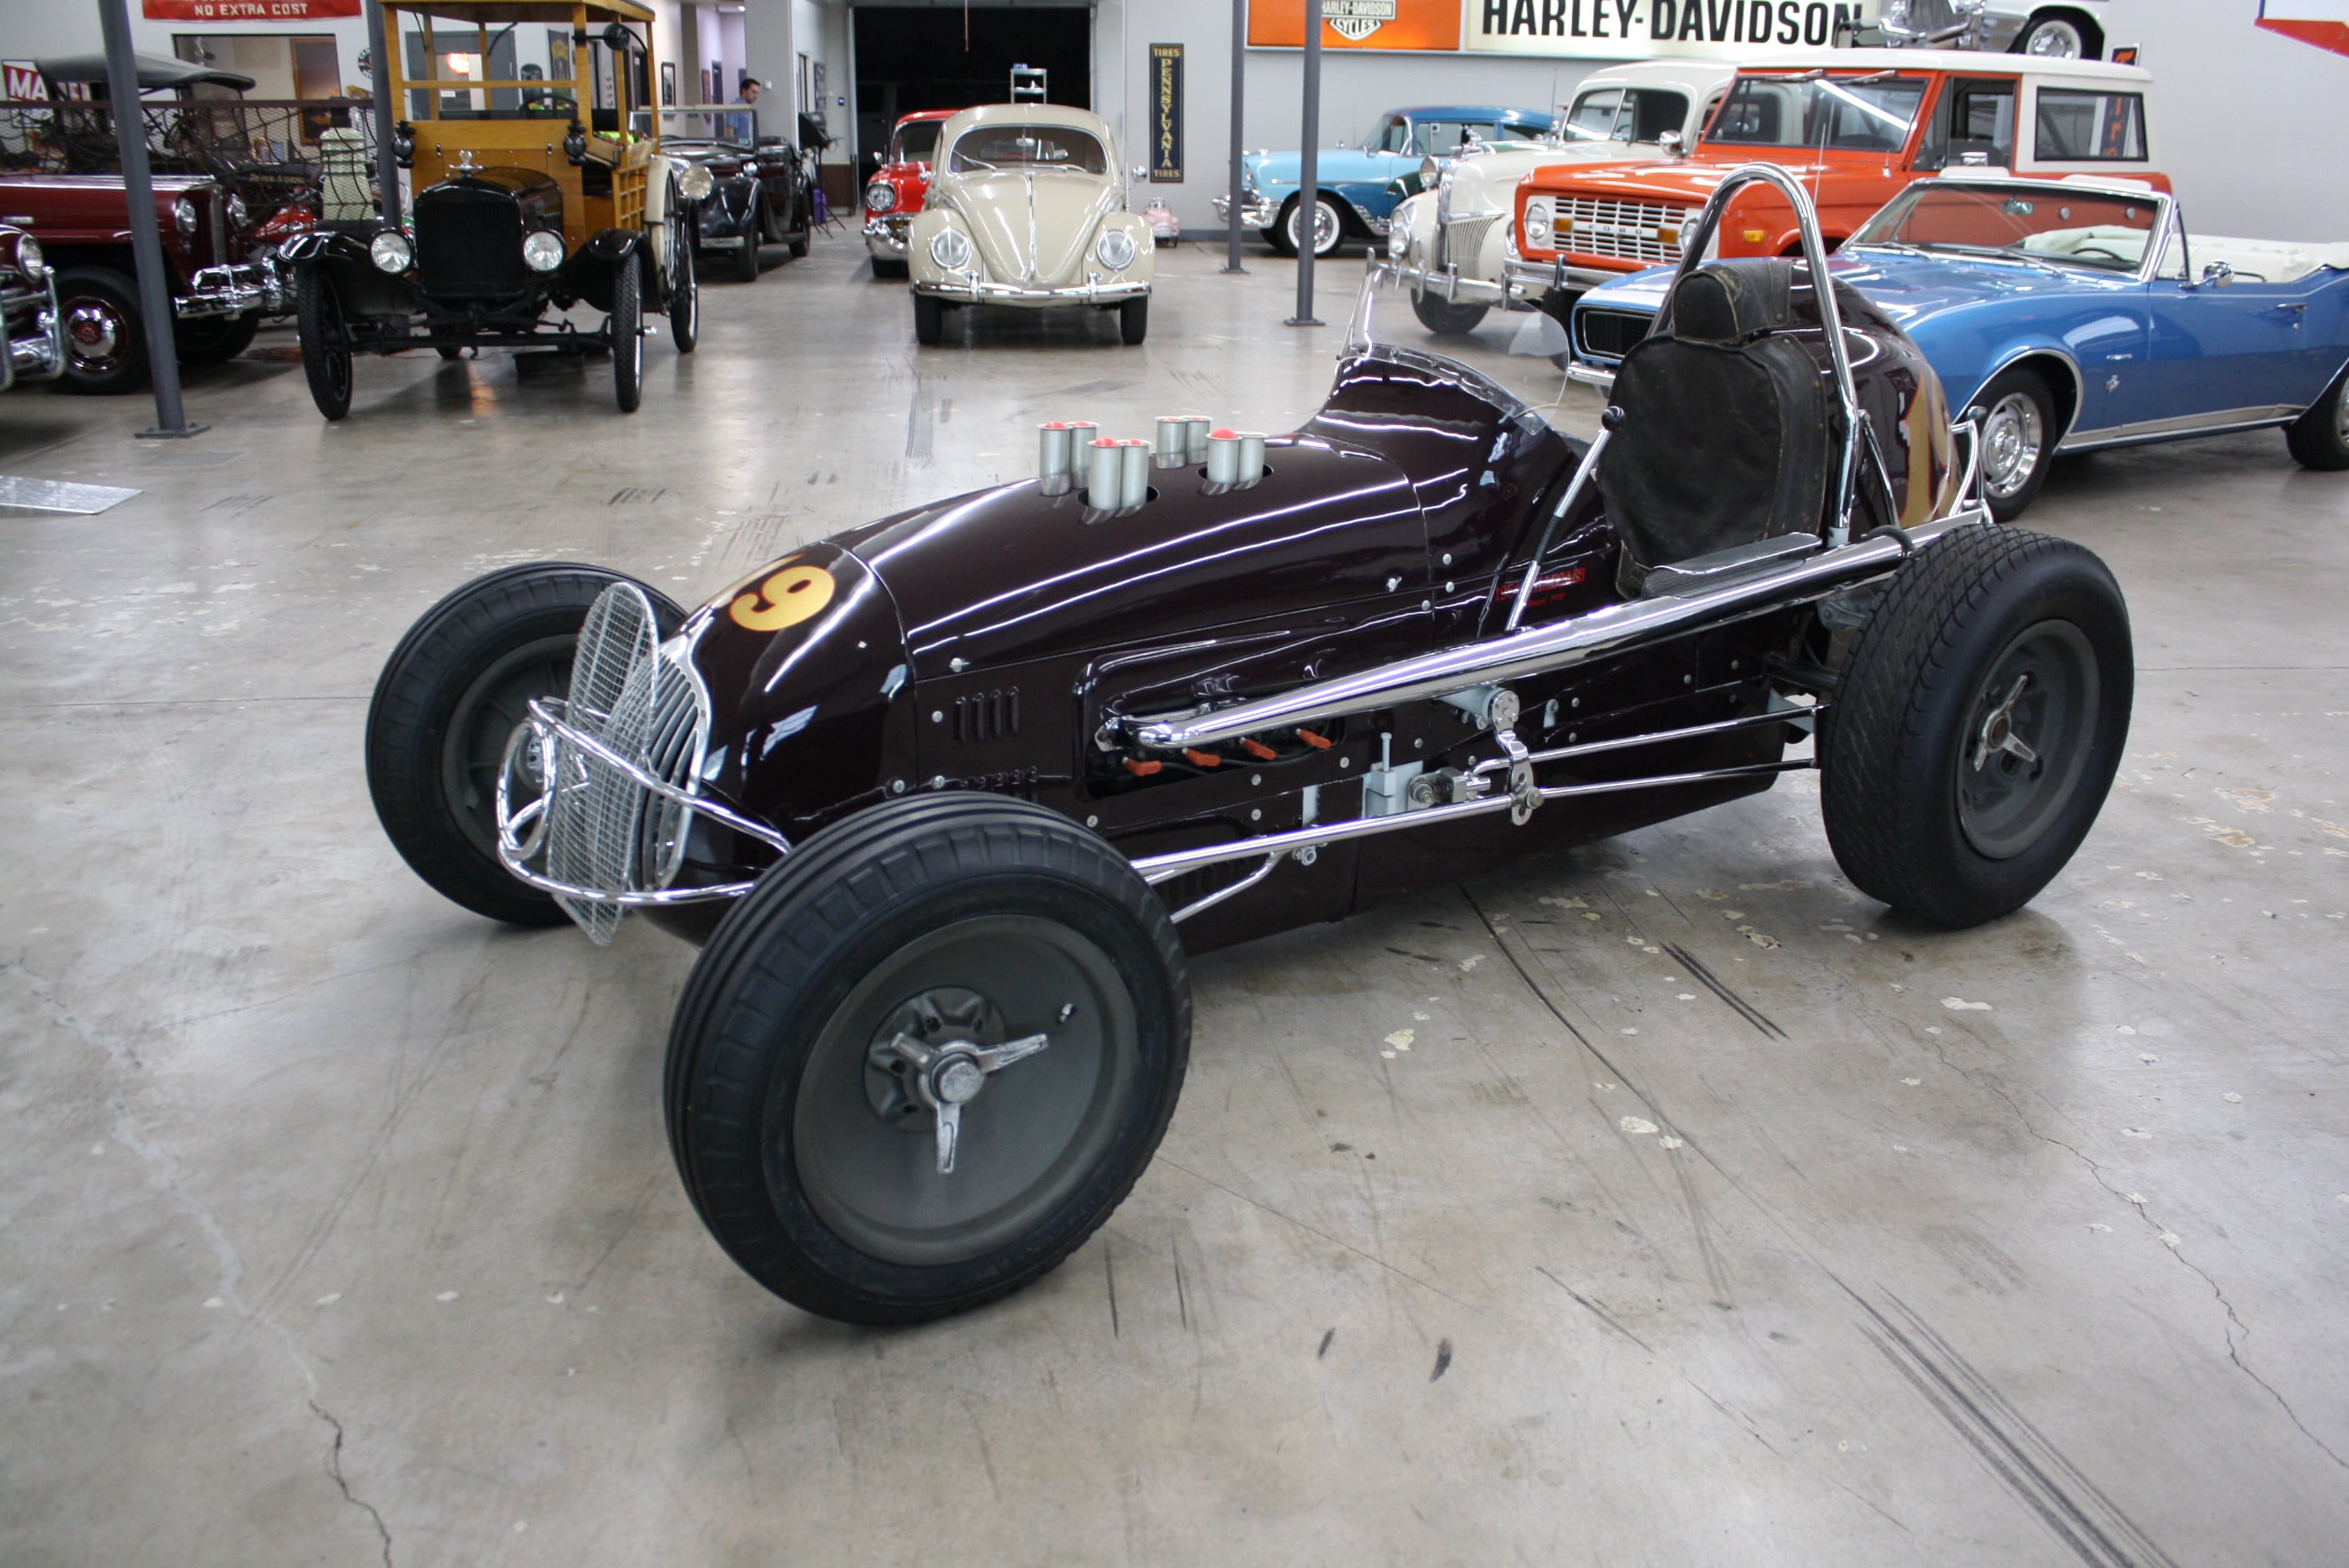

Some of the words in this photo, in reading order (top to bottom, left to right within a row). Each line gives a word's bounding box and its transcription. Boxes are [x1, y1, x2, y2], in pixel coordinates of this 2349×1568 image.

[194, 4, 214, 17] NO
[219, 3, 266, 16] EXTRA
[272, 3, 309, 15] COST
[1335, 18, 1376, 36] CYCLES
[1482, 0, 1863, 47] HARLEY-DAVIDSON
[1154, 48, 1180, 58] TIRES
[1160, 58, 1173, 168] PENNSYLVANIA
[1154, 168, 1180, 178] TIRES
[1588, 224, 1642, 235] FORD
